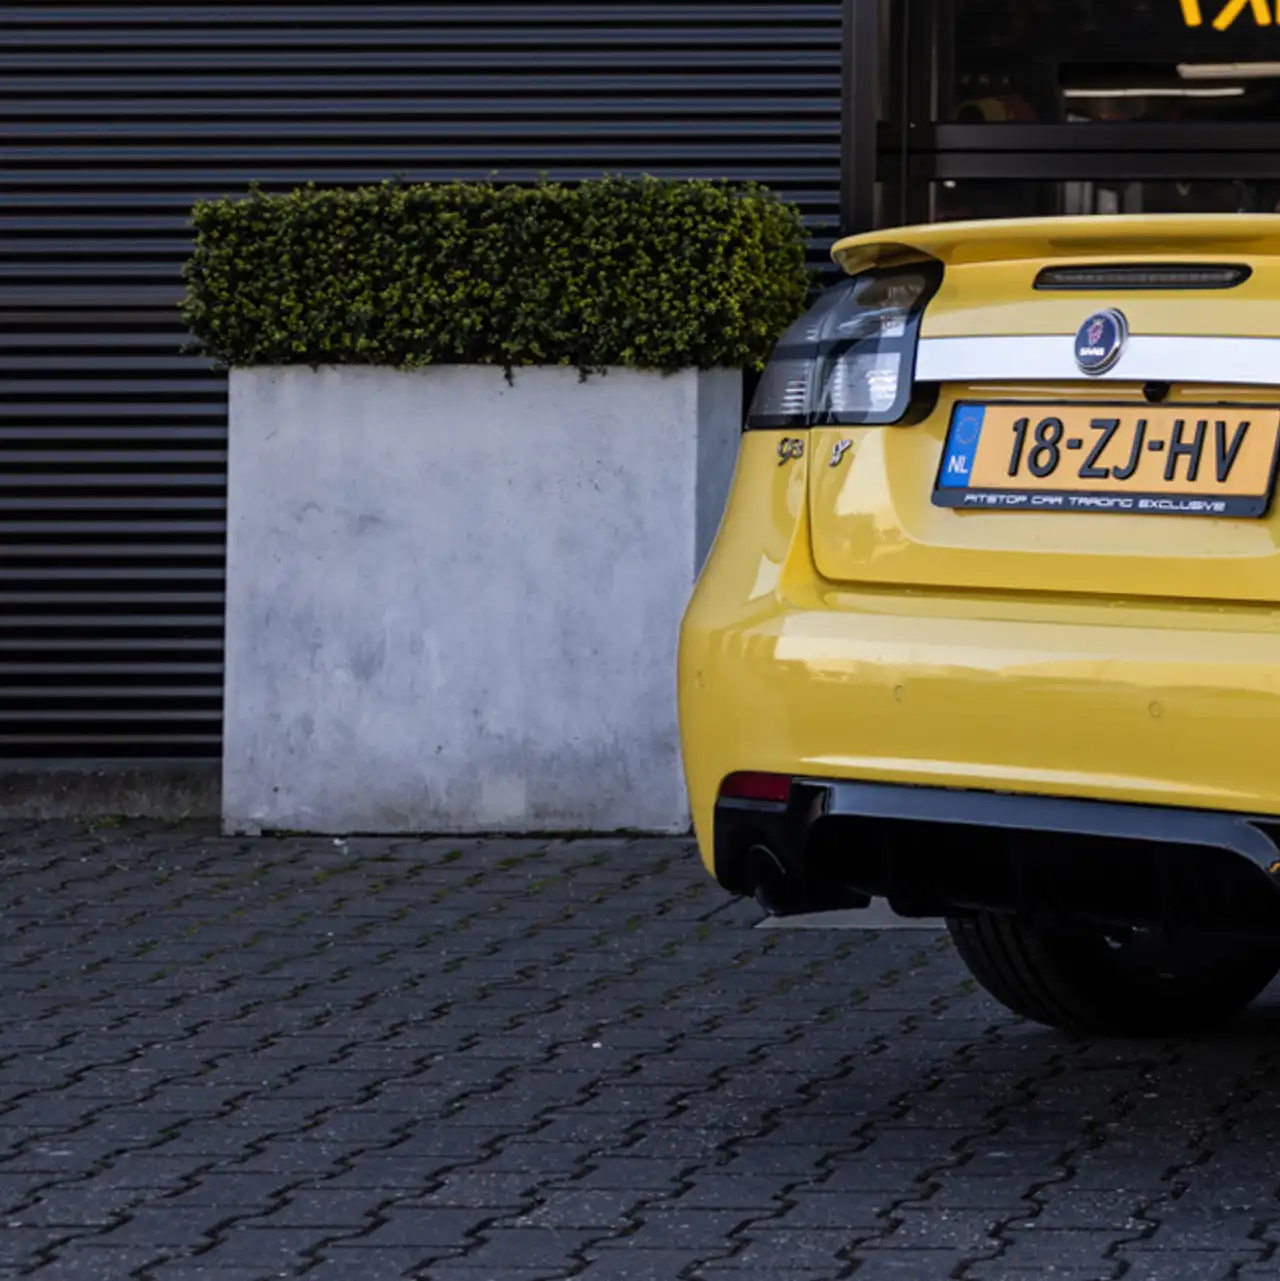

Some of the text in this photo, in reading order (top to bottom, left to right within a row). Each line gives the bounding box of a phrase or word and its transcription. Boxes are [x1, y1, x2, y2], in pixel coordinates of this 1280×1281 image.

[1007, 416, 1251, 483] 18-ZJ-HV
[948, 456, 969, 474] NL
[964, 493, 1226, 512] PITSTOP CAR TRADING EXCLUSIVE
